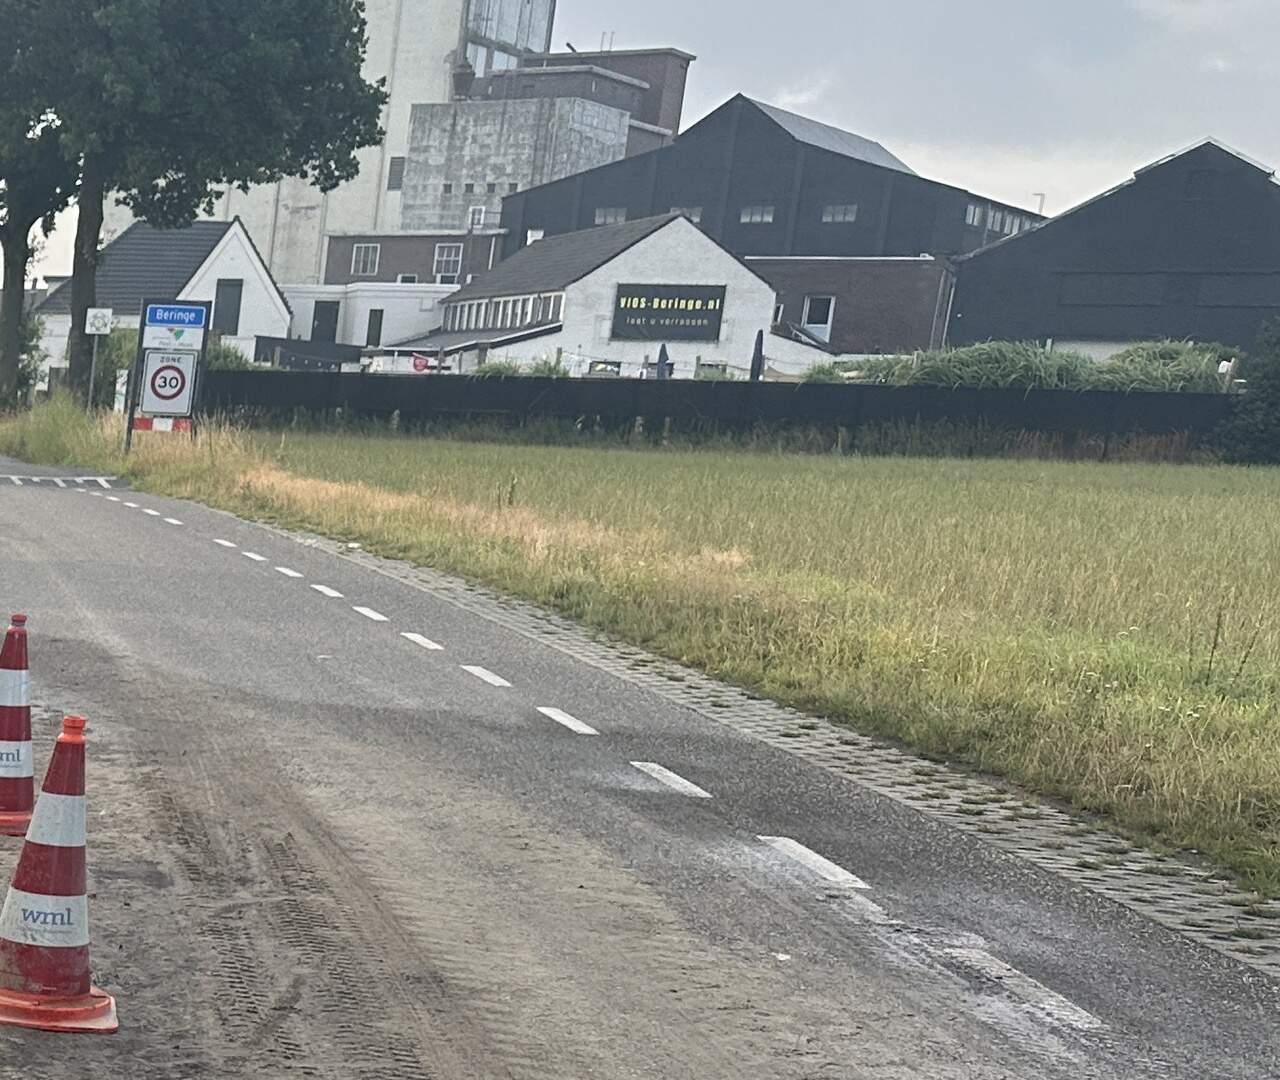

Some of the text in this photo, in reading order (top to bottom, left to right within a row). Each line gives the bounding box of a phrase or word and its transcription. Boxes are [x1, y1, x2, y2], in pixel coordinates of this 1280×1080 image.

[156, 309, 195, 324] Beringe
[158, 376, 179, 388] 30
[21, 907, 74, 926] wml
